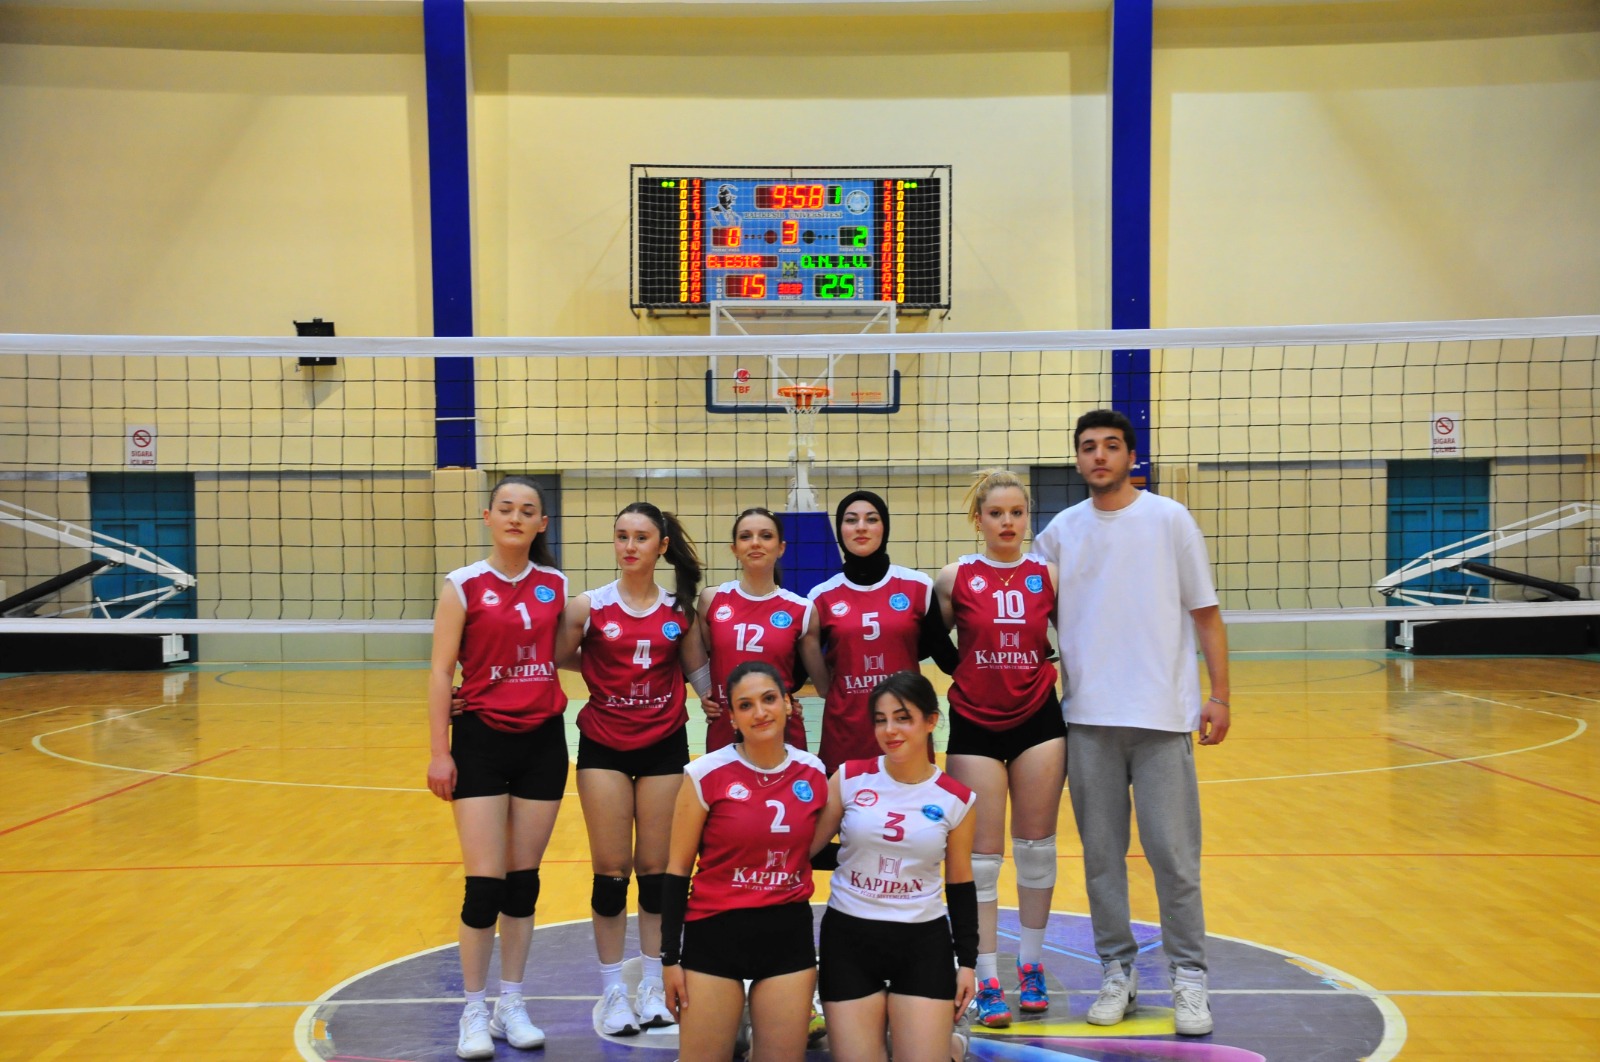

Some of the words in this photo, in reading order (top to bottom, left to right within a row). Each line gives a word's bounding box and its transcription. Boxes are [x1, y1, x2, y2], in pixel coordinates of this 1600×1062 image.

[680, 179, 687, 189] 0
[897, 181, 904, 190] 0
[680, 190, 687, 199] 0
[773, 184, 824, 209] 9:58
[834, 186, 842, 204] 1
[897, 191, 904, 200] 0
[680, 200, 687, 209] 0
[897, 201, 904, 210] 0
[680, 210, 687, 219] 0
[897, 212, 904, 221] 0
[680, 220, 687, 230] 0
[897, 222, 904, 231] 0
[680, 231, 687, 240] 0
[727, 227, 741, 247] 0
[783, 220, 798, 245] 3
[852, 226, 868, 247] 2
[897, 232, 904, 241] 0
[680, 241, 687, 250] 0
[897, 243, 904, 252] 0
[680, 251, 687, 260] 0
[897, 253, 904, 262] 0
[680, 262, 687, 271] 0
[897, 263, 904, 272] 0
[680, 272, 687, 281] 0
[897, 273, 904, 282] 0
[680, 282, 687, 291] 0
[741, 273, 766, 298] 15
[820, 274, 854, 298] 25
[897, 284, 904, 292] 0
[680, 292, 687, 302] 0
[897, 294, 904, 303] 0
[732, 385, 750, 394] TBF
[992, 589, 1026, 619] 10
[514, 602, 532, 630] 1
[862, 611, 880, 641] 5
[733, 622, 765, 653] 12
[632, 639, 652, 670] 4
[975, 649, 1039, 664] KAPIPAN
[765, 799, 791, 833] 2
[883, 811, 906, 842] 3
[850, 870, 923, 893] KAPIPAN
